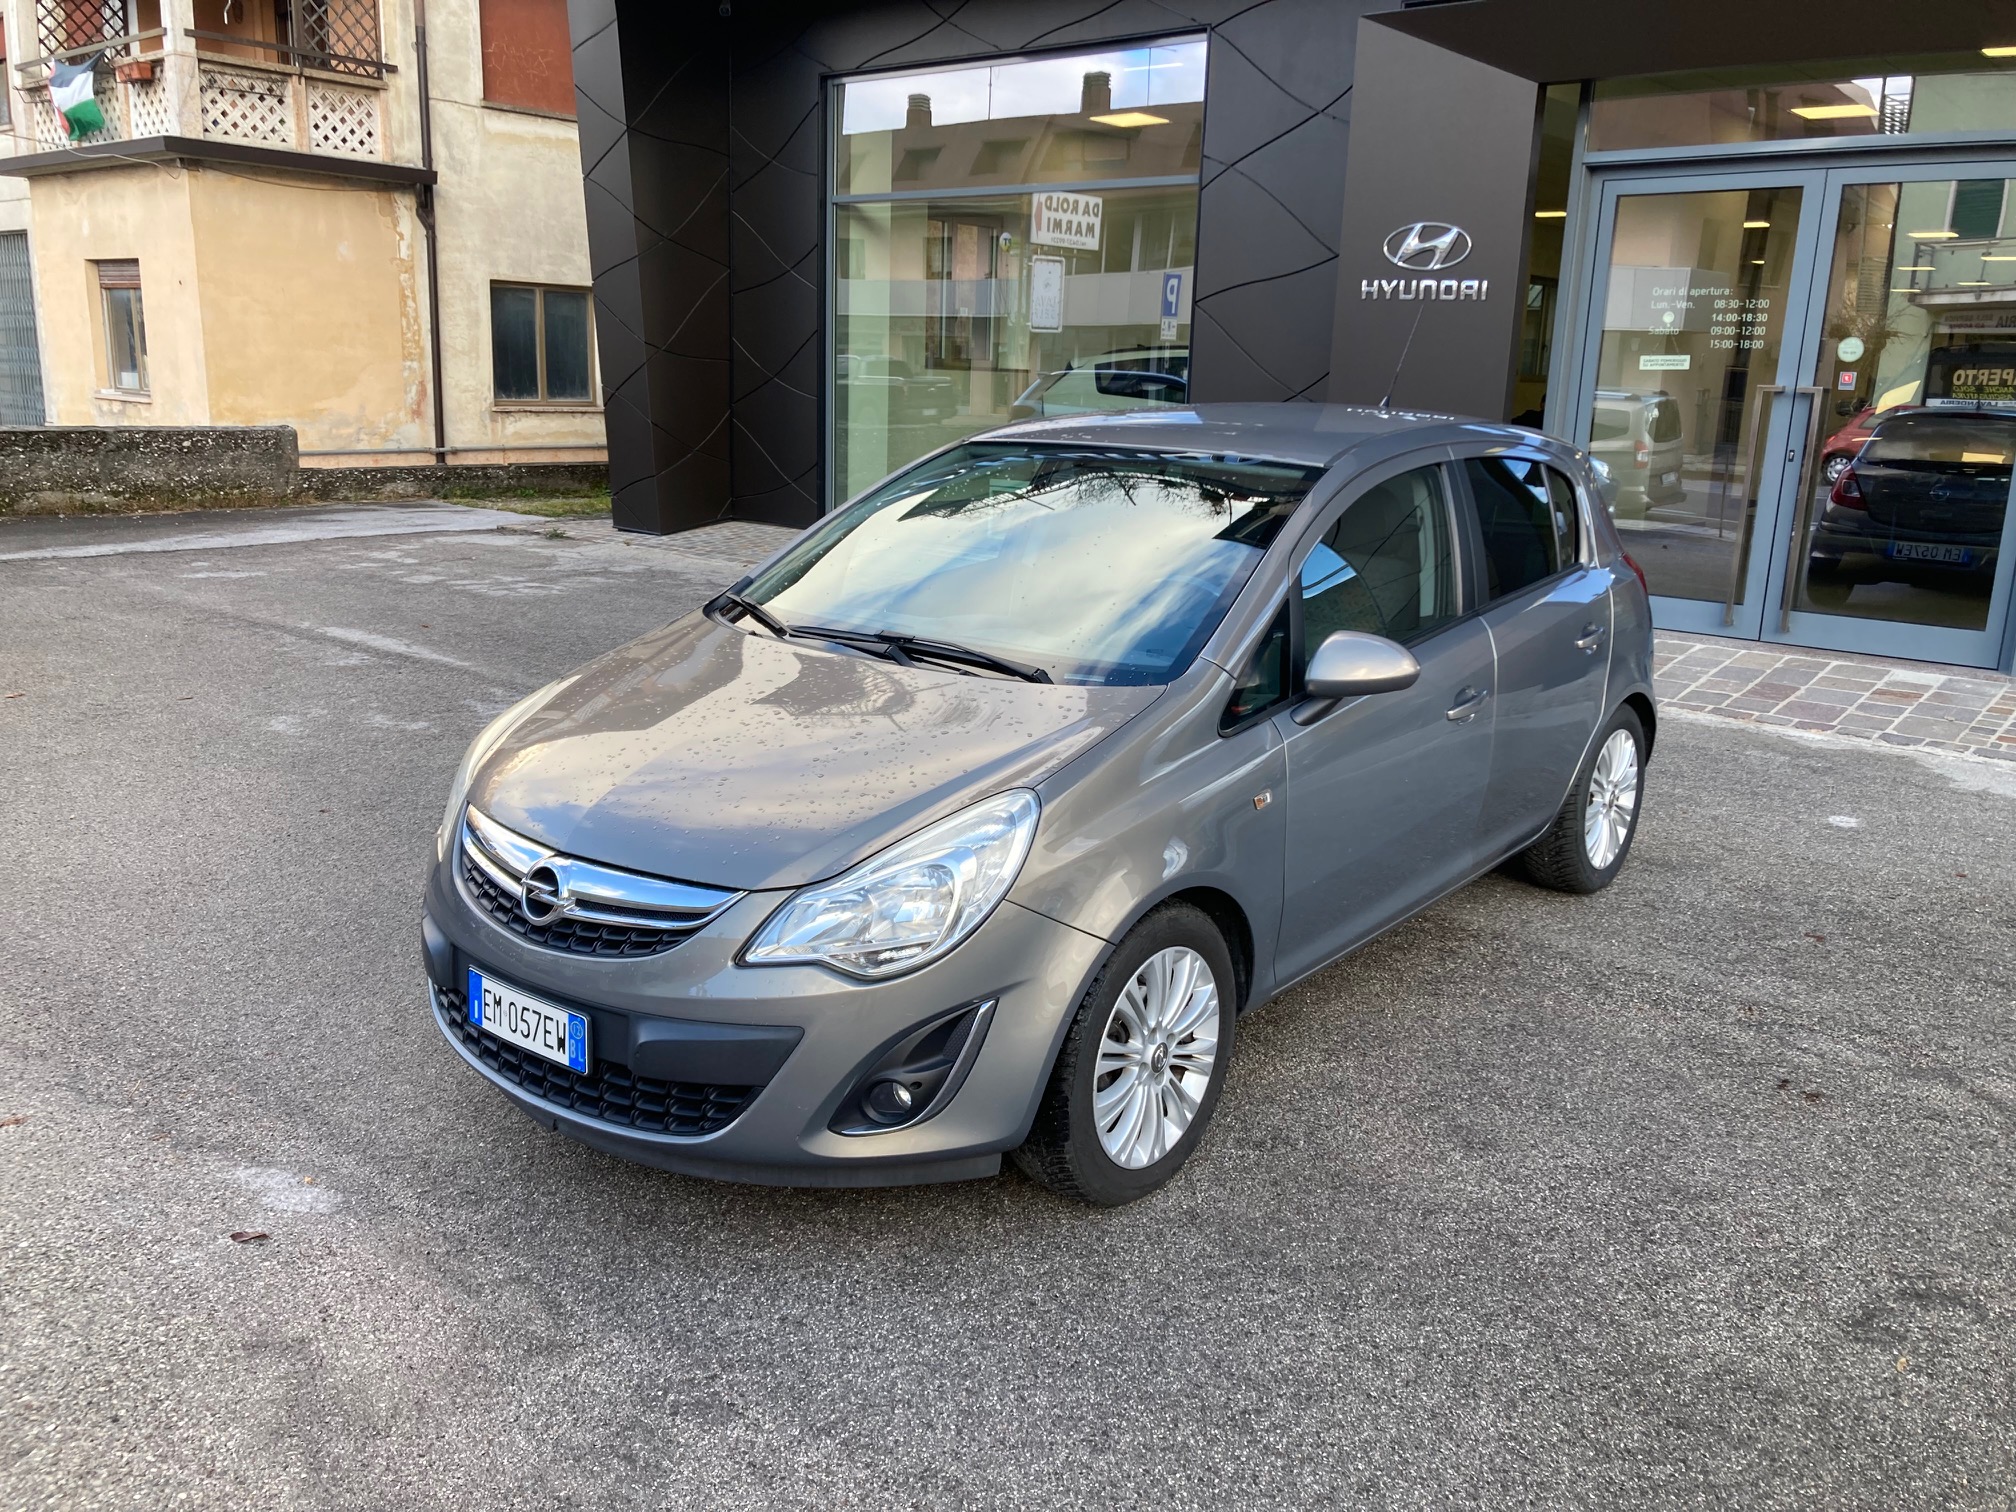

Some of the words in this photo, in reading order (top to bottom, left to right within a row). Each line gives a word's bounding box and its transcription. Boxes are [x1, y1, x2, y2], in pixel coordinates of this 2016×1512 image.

[1361, 279, 1489, 300] HYUNDAI
[1652, 286, 1677, 297] Orari
[1678, 286, 1687, 296] di
[1689, 286, 1734, 298] apertura:
[1714, 299, 1770, 309] 08:30-12:00
[1712, 313, 1768, 322] 14:00-18:30
[1648, 326, 1680, 335] Sabato
[1710, 326, 1766, 335] 09:00-12:00
[1709, 340, 1764, 349] 15:00-18:00
[483, 988, 502, 1027] EM
[508, 1001, 567, 1055] 057EW
[570, 1039, 584, 1062] BL
